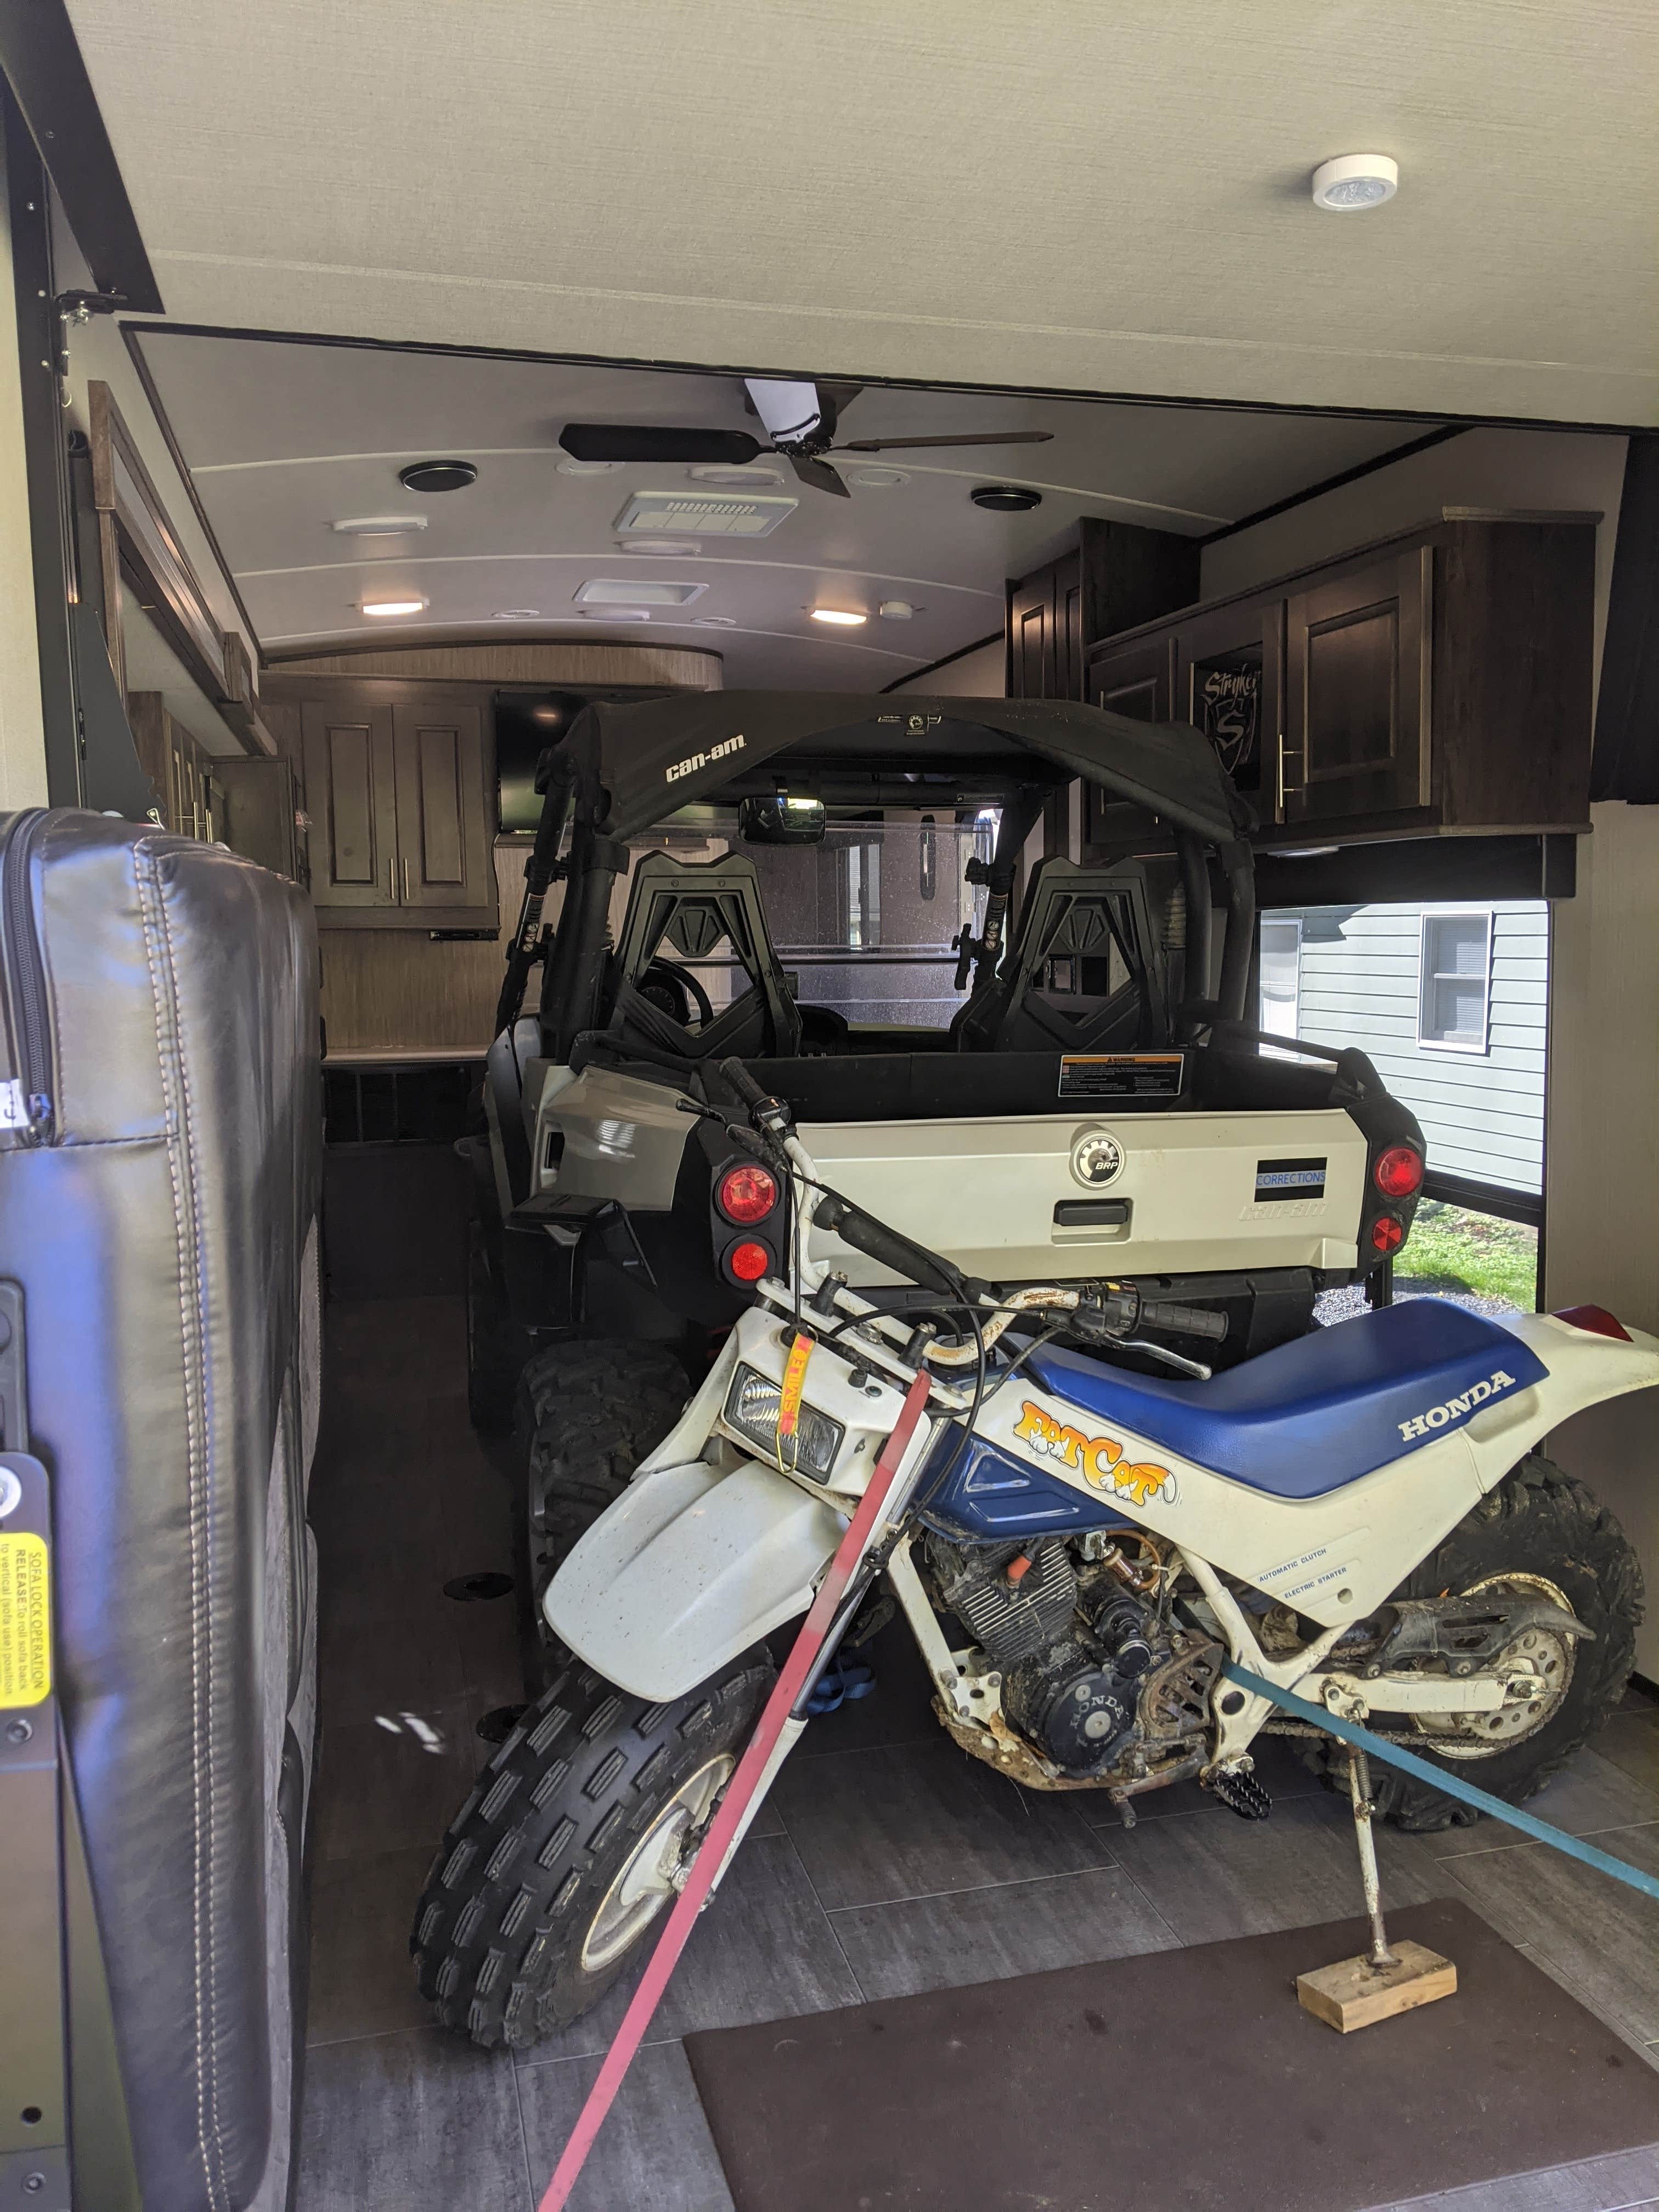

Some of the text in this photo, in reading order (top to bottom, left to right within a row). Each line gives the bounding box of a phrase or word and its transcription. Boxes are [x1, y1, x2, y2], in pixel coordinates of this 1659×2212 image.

[1095, 1161, 1119, 1170] BRP
[1256, 1171, 1325, 1186] CORRECTIONS
[1398, 1370, 1516, 1442] HONDA
[1, 1543, 10, 1554] to
[1, 1556, 12, 1594] vertical
[1259, 1548, 1327, 1582] AUTOMATIC CLUTCH
[1284, 1566, 1347, 1599] ELECTRIC STARTER
[18, 1621, 28, 1637] roll
[31, 1552, 44, 1689] SOFA LOCK OPERATION
[18, 1641, 29, 1663] sofa
[2, 1653, 15, 1695] position
[19, 1665, 29, 1690] back
